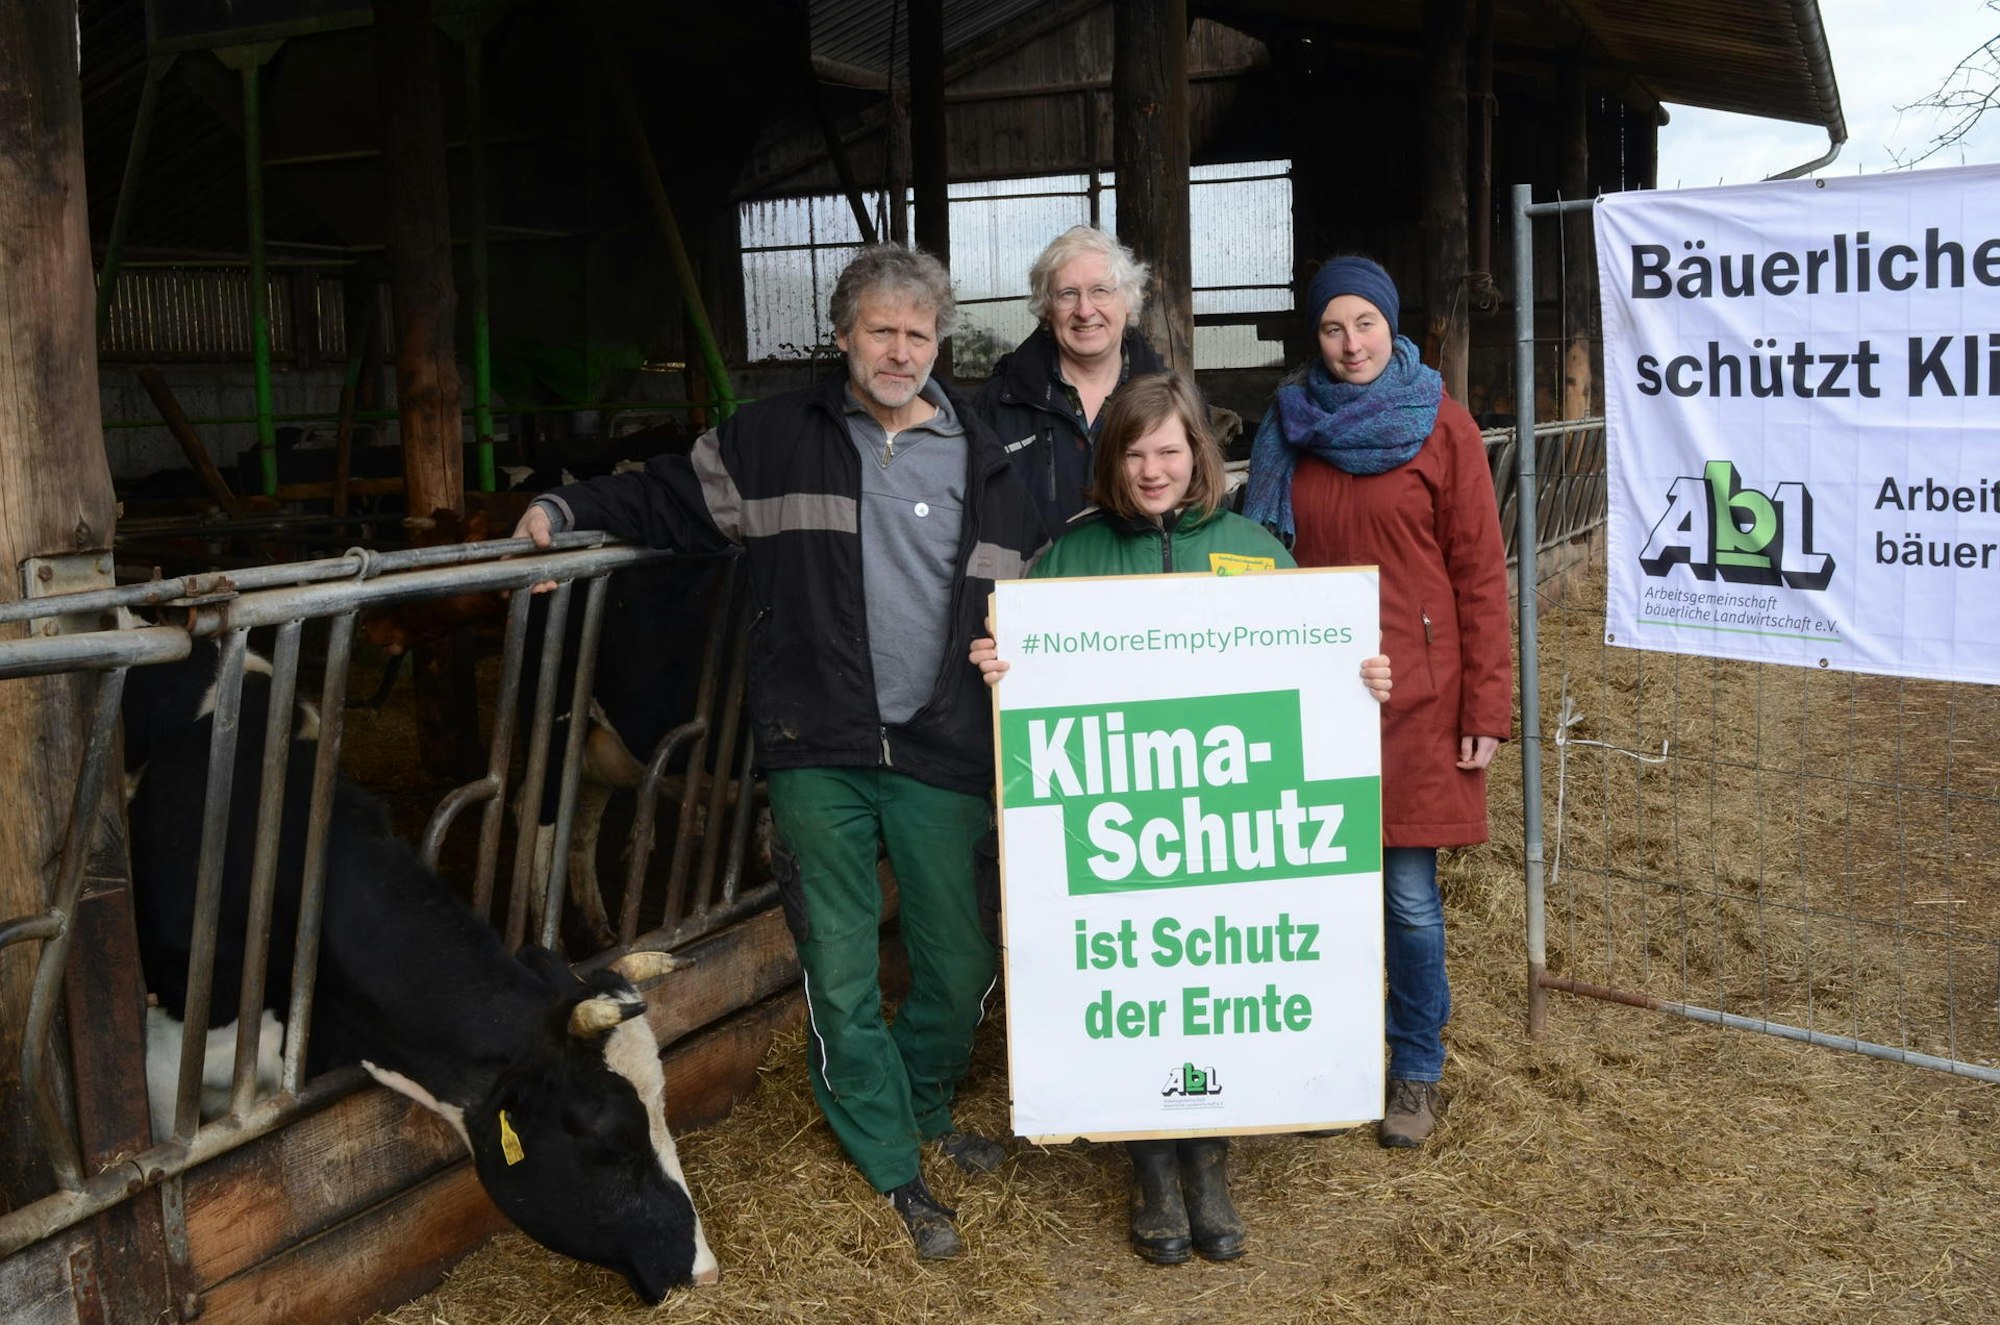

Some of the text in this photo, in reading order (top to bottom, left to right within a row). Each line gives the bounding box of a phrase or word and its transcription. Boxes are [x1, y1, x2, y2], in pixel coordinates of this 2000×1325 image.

[1631, 228, 2000, 299] Bäuerliche
[1637, 333, 2000, 398] schützt Kli
[1874, 476, 2000, 513] Arbeit
[1876, 531, 2000, 569] bäuer
[1645, 586, 1777, 612] Arbeitsgemeinschaft
[1645, 603, 1840, 634] bäuerliche Landwirtschaft e.V.
[1022, 623, 1352, 655] #NoMoreEmptyPromises
[1028, 711, 1272, 799] Klima-
[1087, 789, 1347, 881] Schutz
[1074, 912, 1320, 971] ist Schutz
[1085, 983, 1313, 1040] der Ernte
